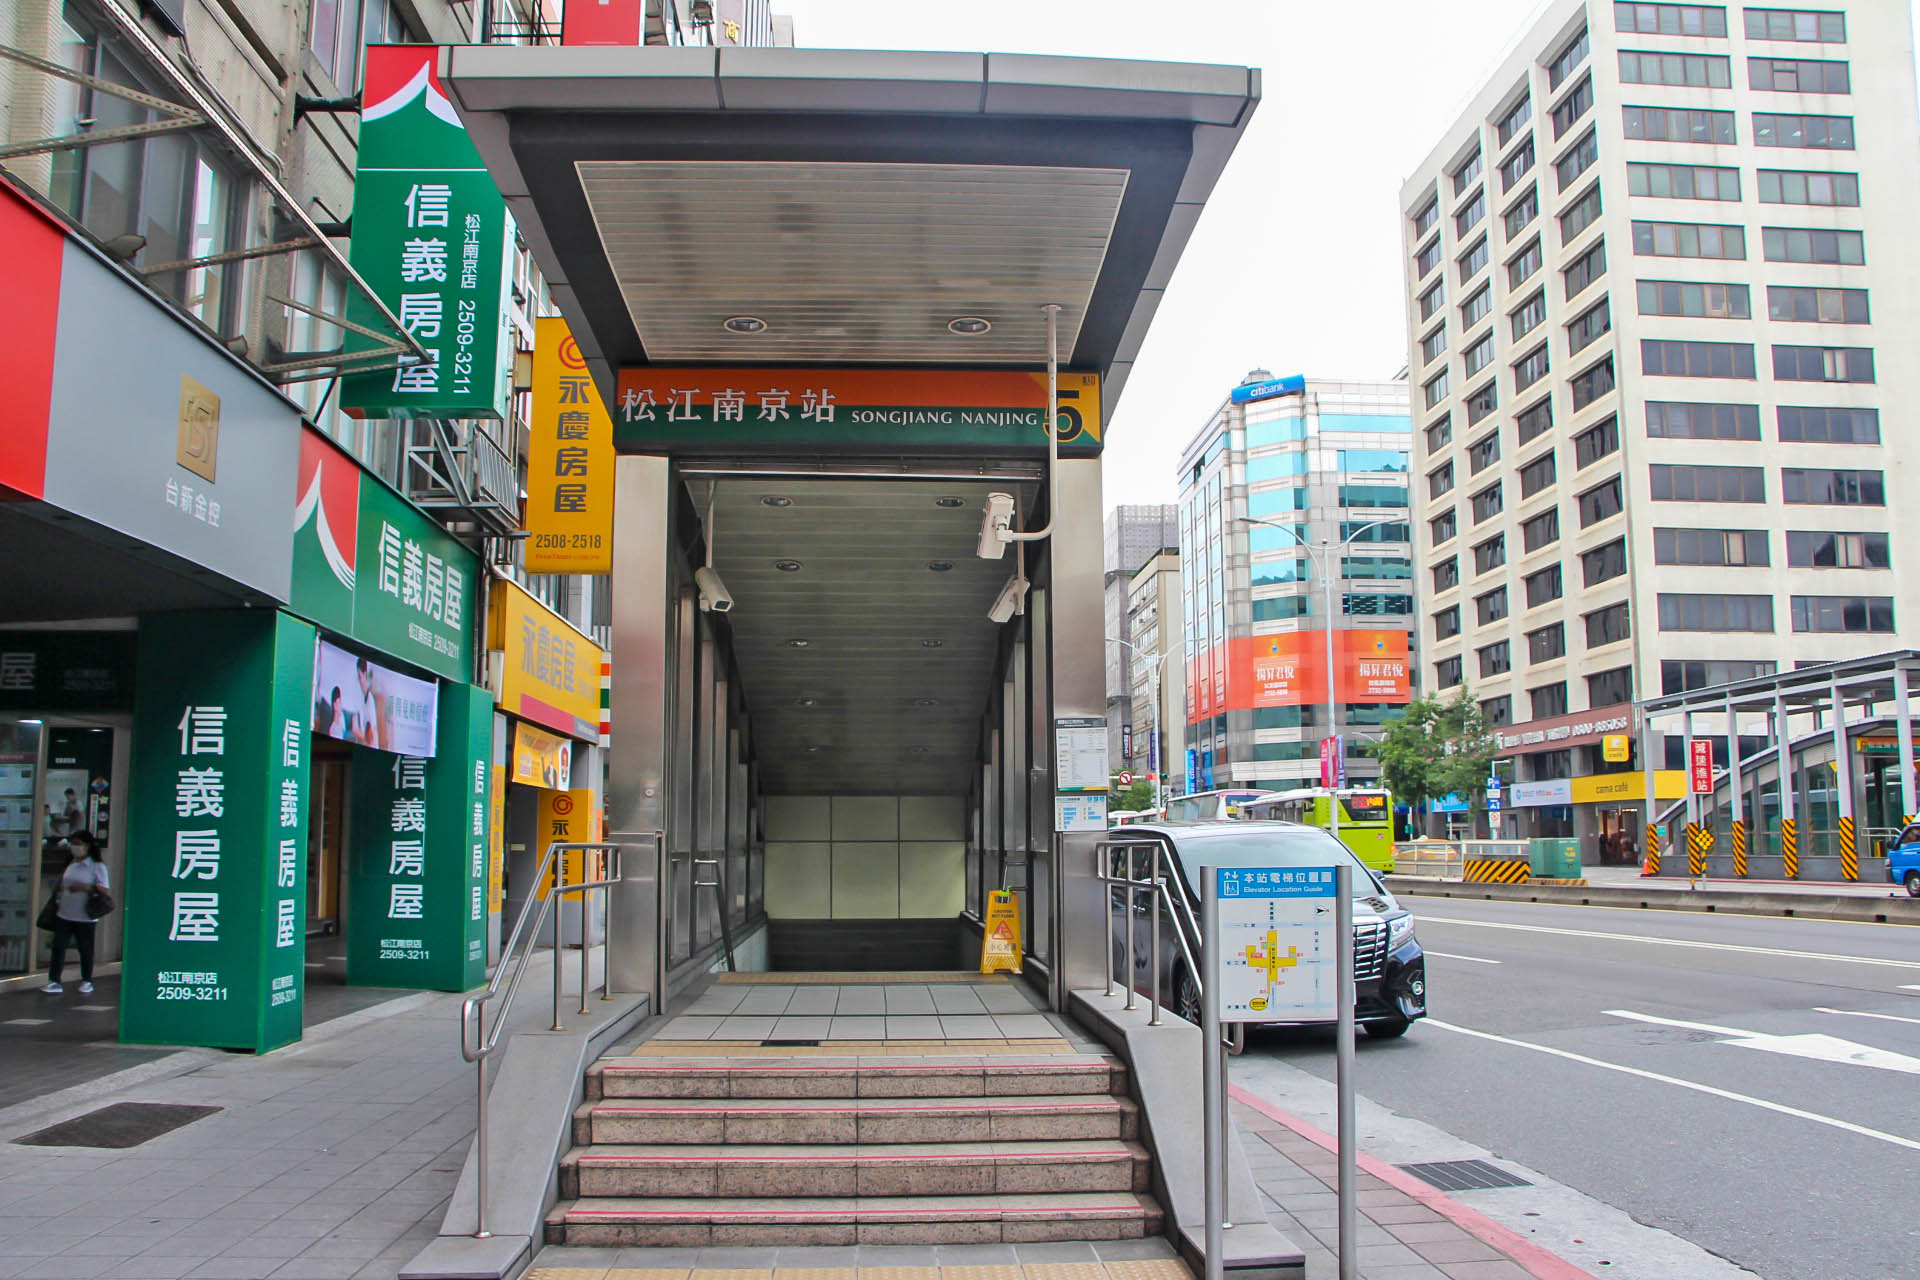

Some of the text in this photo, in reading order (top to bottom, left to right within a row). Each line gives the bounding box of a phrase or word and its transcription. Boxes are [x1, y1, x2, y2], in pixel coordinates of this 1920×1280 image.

[392, 184, 452, 393] 信義房屋
[453, 213, 481, 394] 松江南京店 2509-3211
[621, 387, 1084, 443] 松江南京站 SONGJIANG NANJING 5
[1250, 382, 1284, 397] citibank
[554, 375, 591, 512] 永慶房屋
[166, 478, 220, 527] 台新金控
[379, 520, 463, 631] 信義房屋
[535, 534, 601, 549] 2508-2518
[522, 613, 577, 694] 永慶房屋
[168, 706, 228, 942] 信義房屋
[1596, 786, 1613, 794] cama
[276, 718, 300, 948] 信義房屋
[387, 756, 427, 919] 信義房屋
[471, 760, 485, 920] 信義房屋
[1244, 872, 1332, 883] 本站電梯位
[157, 971, 218, 985] 松江南京店
[379, 950, 430, 960] 2509-3211
[155, 986, 228, 1001] 2509-3211
